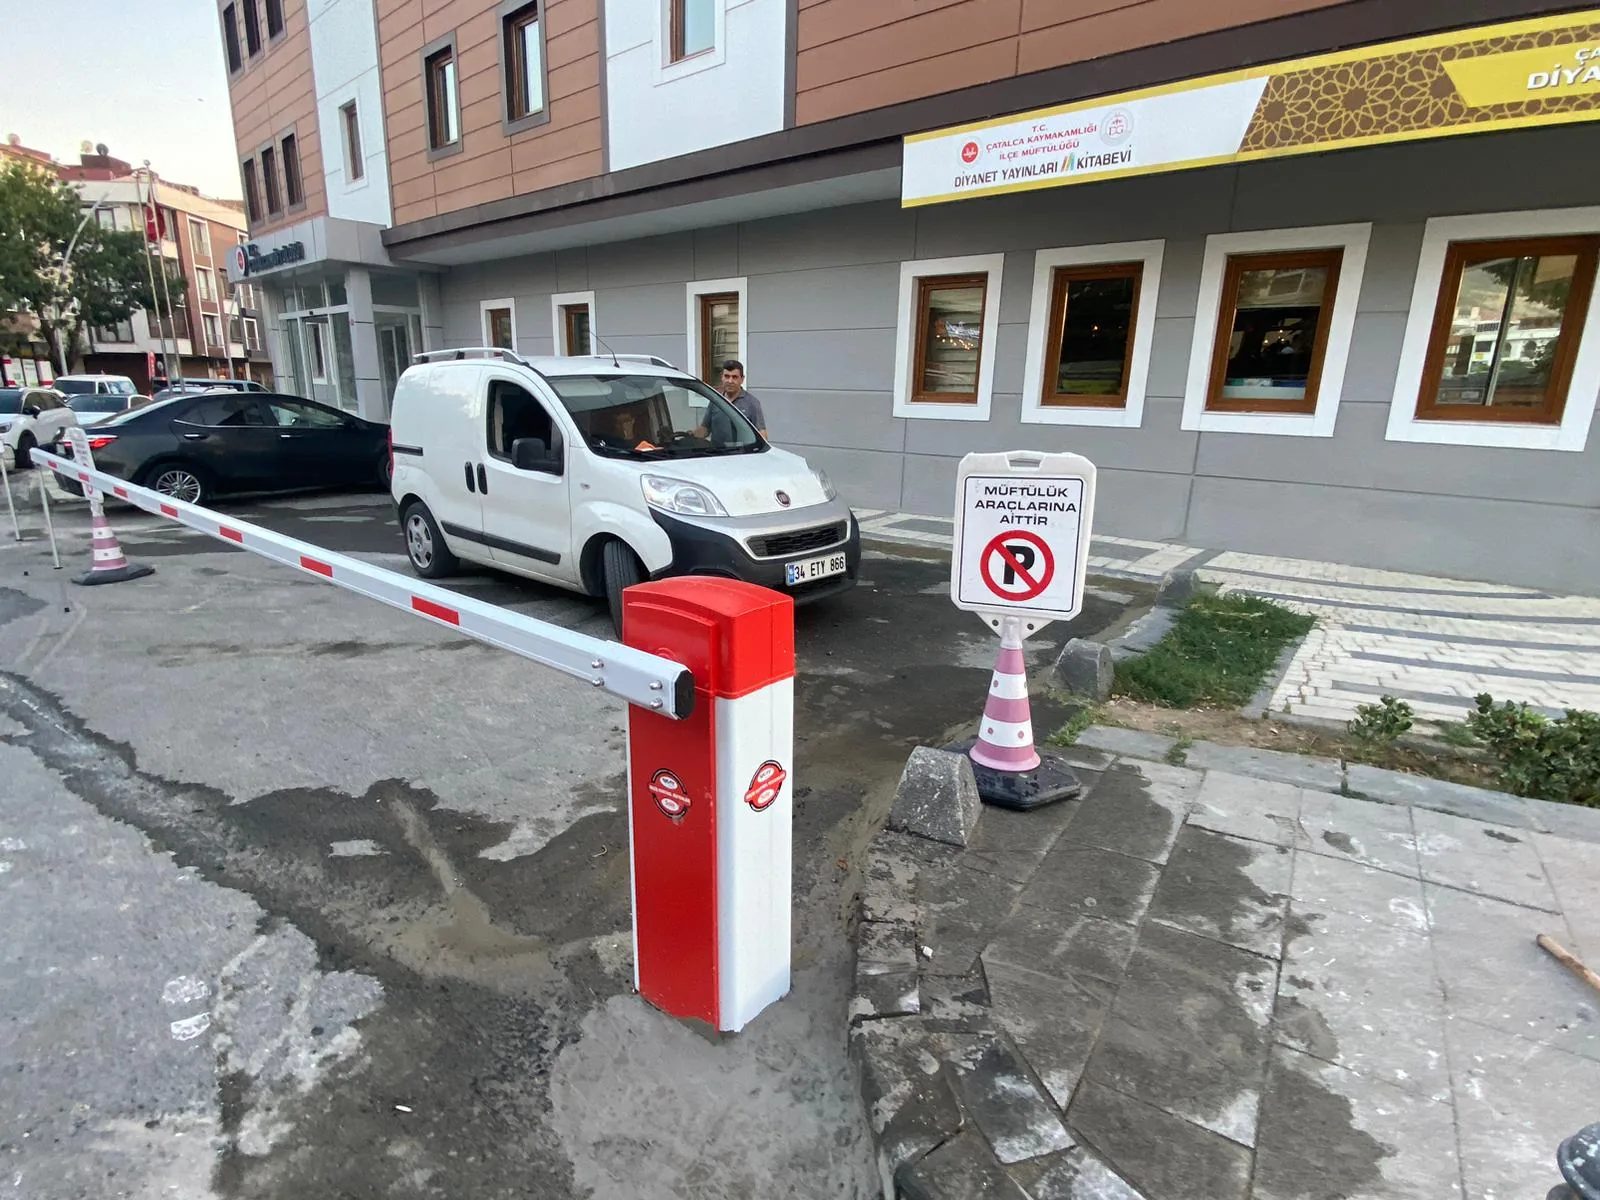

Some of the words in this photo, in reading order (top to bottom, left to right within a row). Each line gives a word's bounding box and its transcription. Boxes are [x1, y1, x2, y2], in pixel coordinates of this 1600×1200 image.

[986, 138, 1025, 152] ÇATALCA
[1027, 124, 1097, 143] KAYMAKAMLIĞI
[1021, 141, 1080, 156] MÜFTÜLÜĞÜ
[954, 170, 998, 188] DİYANET
[1002, 161, 1058, 181] YAYINLARI
[1076, 144, 1132, 170] KİTABEVİ
[984, 484, 1068, 497] MÜFTÜLÜK
[974, 500, 1077, 513] ARAÇLARINA
[1000, 513, 1048, 526] AİTTİR
[795, 565, 805, 579] 34
[810, 560, 826, 577] ETY
[830, 557, 844, 571] 866
